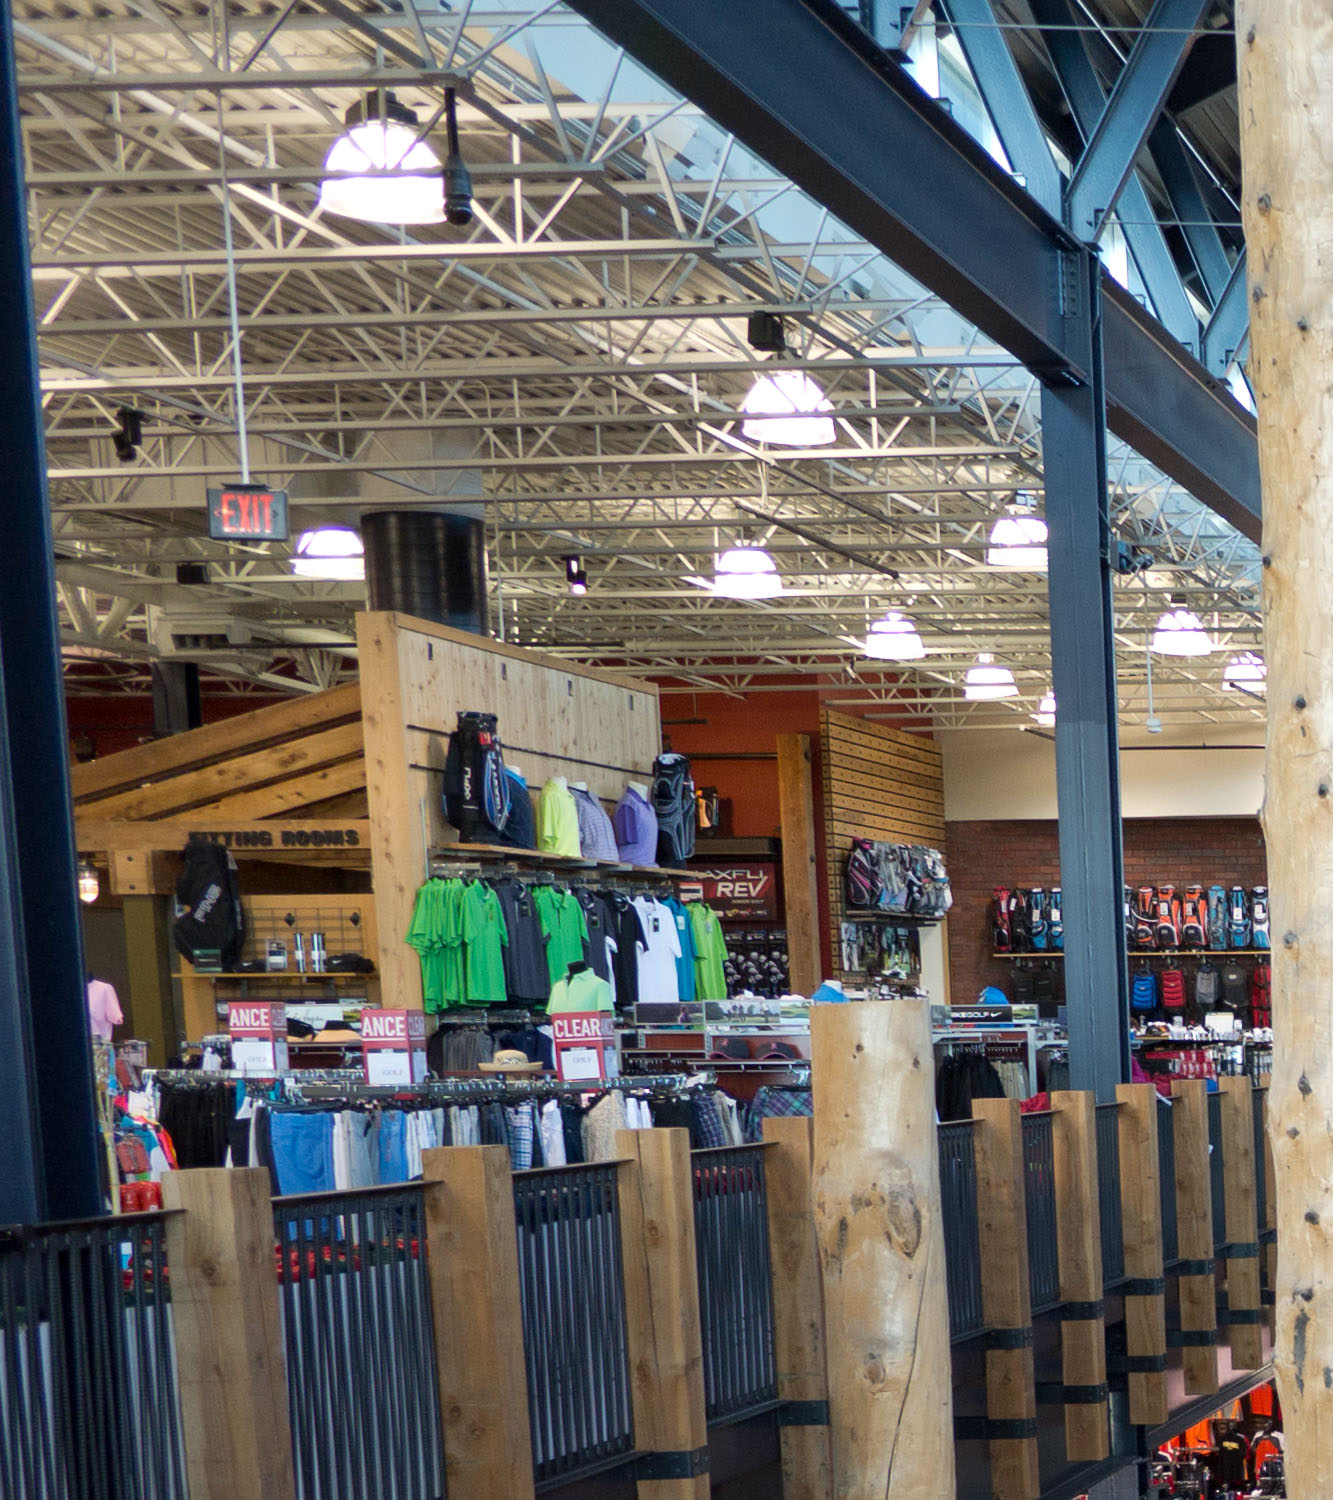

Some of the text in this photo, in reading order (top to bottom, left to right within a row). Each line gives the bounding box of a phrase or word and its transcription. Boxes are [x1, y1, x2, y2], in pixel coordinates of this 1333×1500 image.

[221, 493, 274, 533] EXIT
[281, 829, 360, 847] ROOMS
[703, 869, 763, 880] AXFLI
[716, 876, 768, 898] REV
[229, 1008, 270, 1027] ANCE
[362, 1015, 406, 1037] ANCE
[554, 1018, 602, 1038] CLEAR
